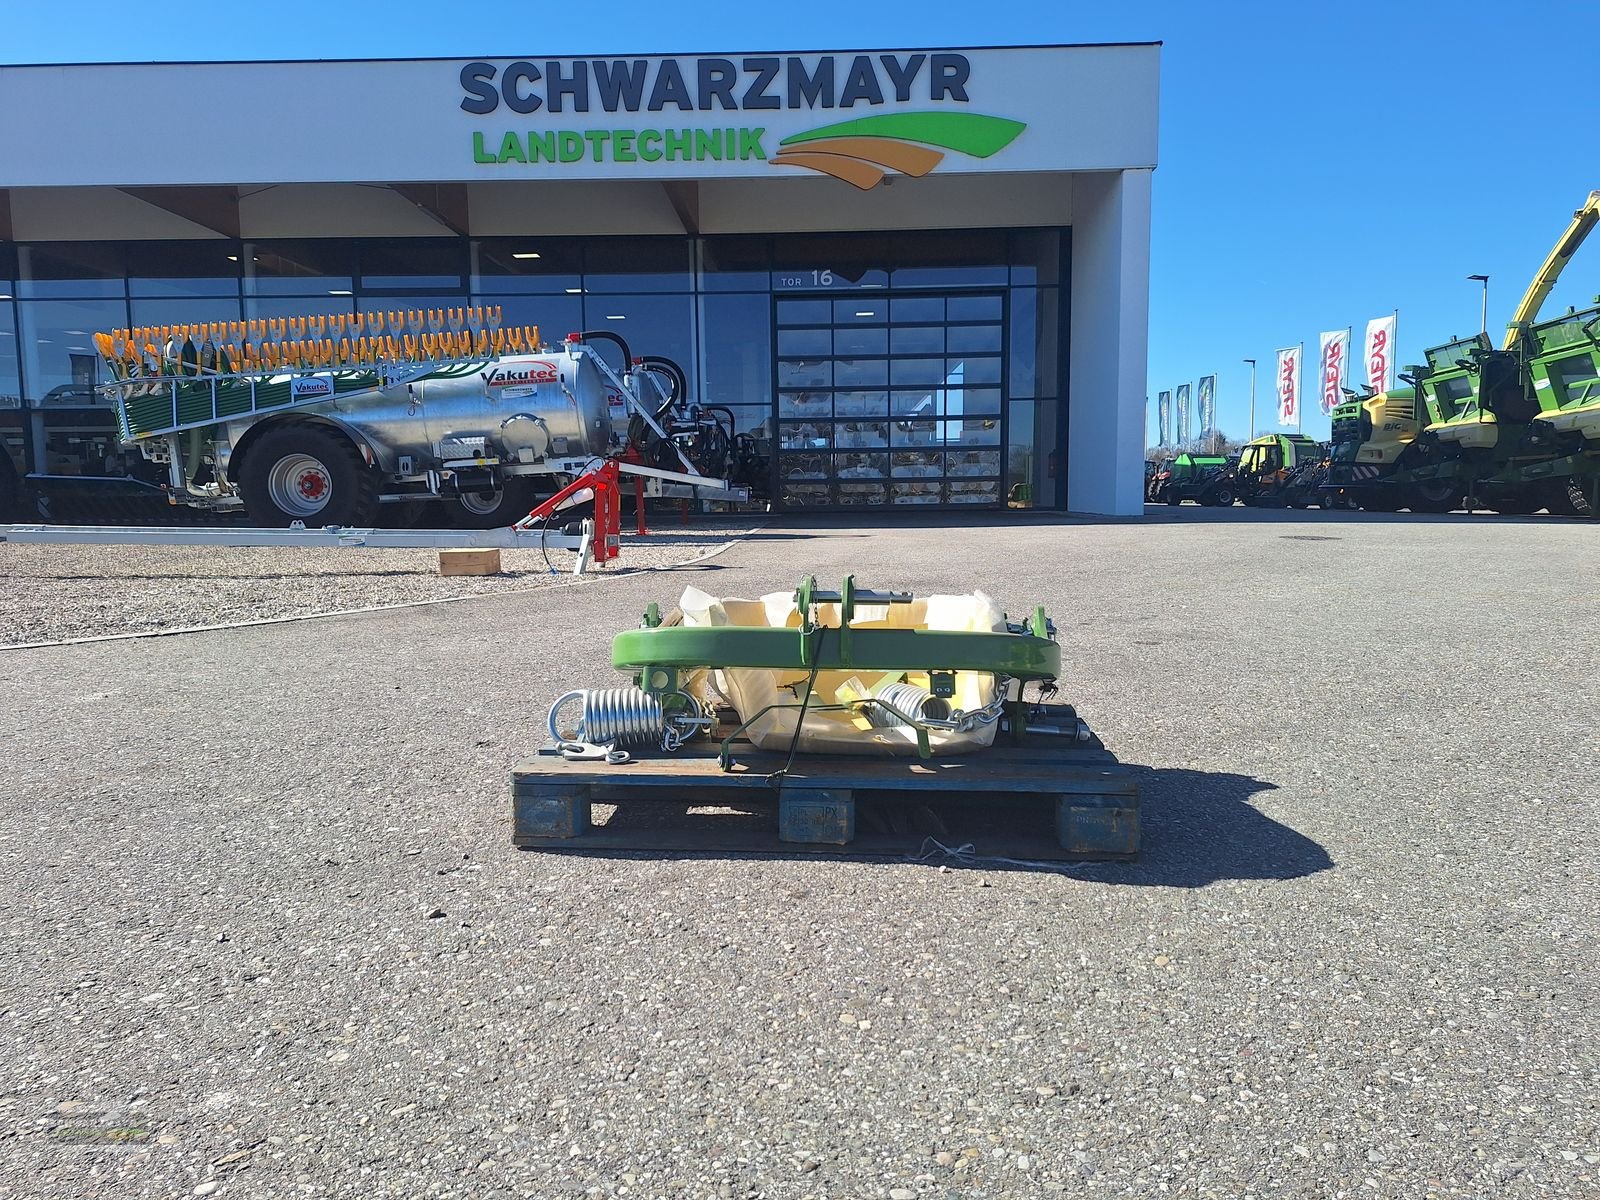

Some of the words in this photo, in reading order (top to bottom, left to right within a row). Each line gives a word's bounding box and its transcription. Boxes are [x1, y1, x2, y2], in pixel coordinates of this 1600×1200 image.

[459, 53, 971, 114] SCHWARZMAYR
[472, 127, 767, 163] LANDTECHNIK
[781, 278, 802, 286] TOR
[811, 269, 833, 286] 16
[480, 368, 558, 386] Vakutec
[294, 382, 329, 393] Vakutec
